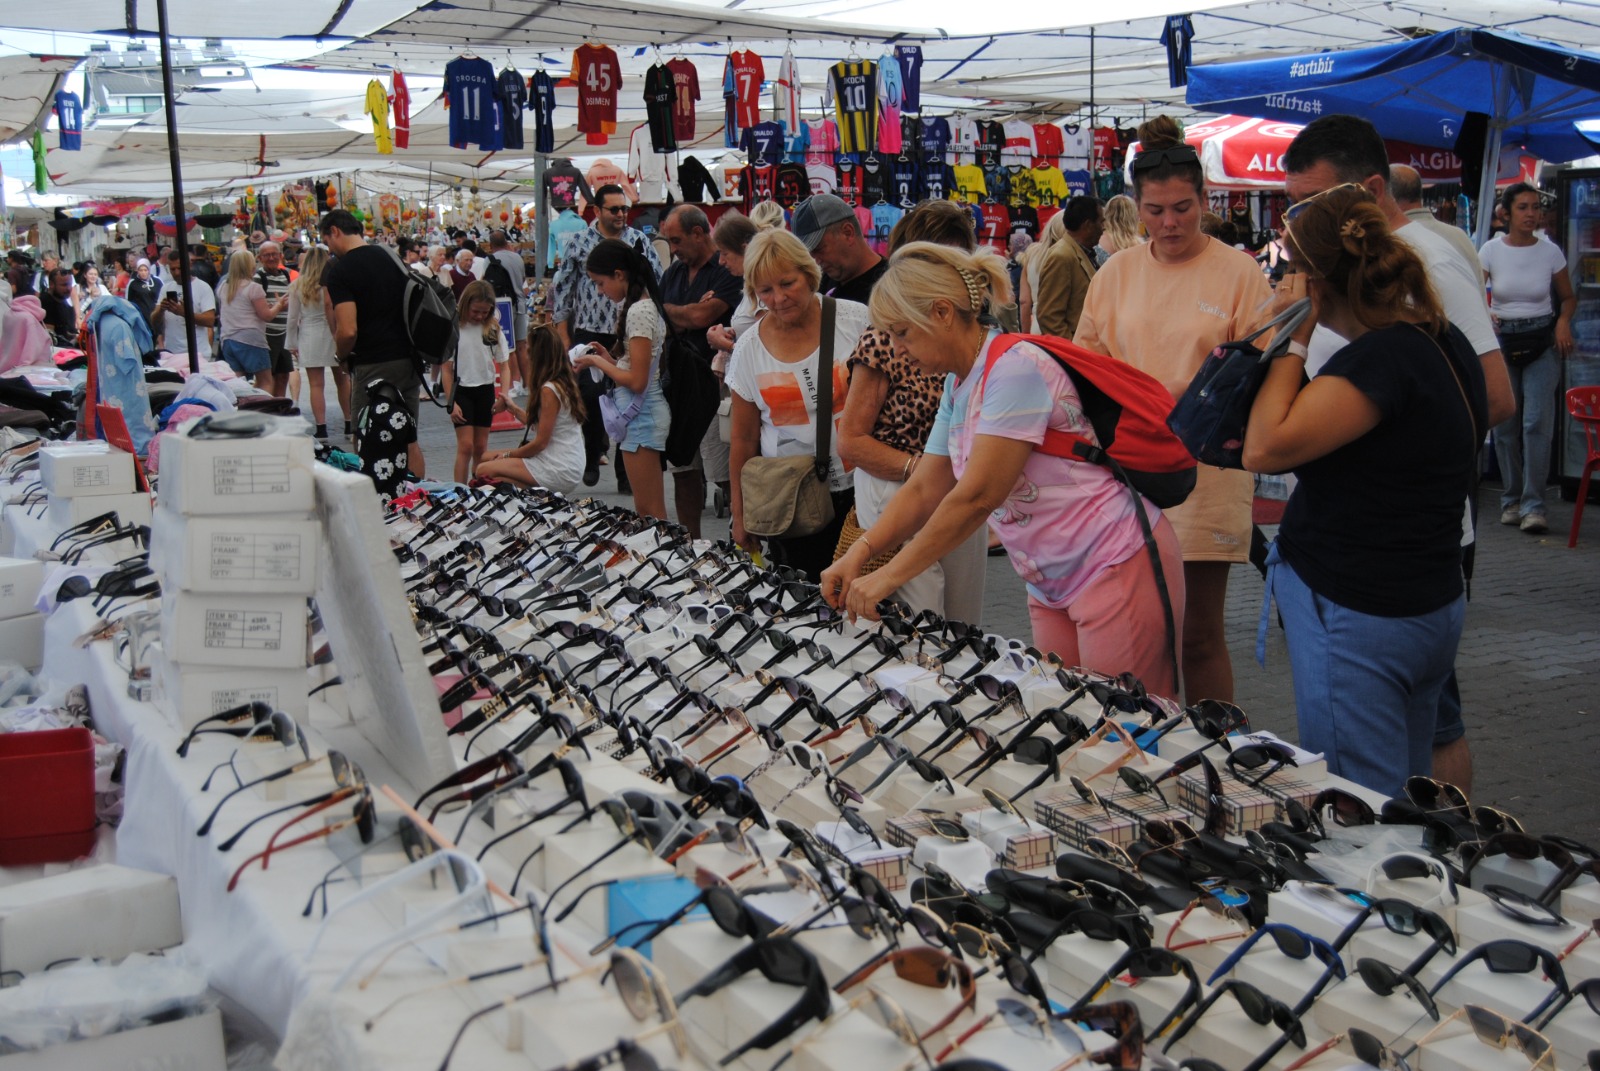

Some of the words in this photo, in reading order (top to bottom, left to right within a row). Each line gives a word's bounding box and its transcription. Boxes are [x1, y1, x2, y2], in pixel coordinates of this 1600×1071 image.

[456, 75, 487, 85] DROGBA
[586, 62, 612, 92] 45
[740, 74, 752, 103] 7
[462, 86, 480, 121] 11
[844, 84, 867, 112] 10
[985, 223, 997, 247] 7
[801, 368, 816, 393] MADE
